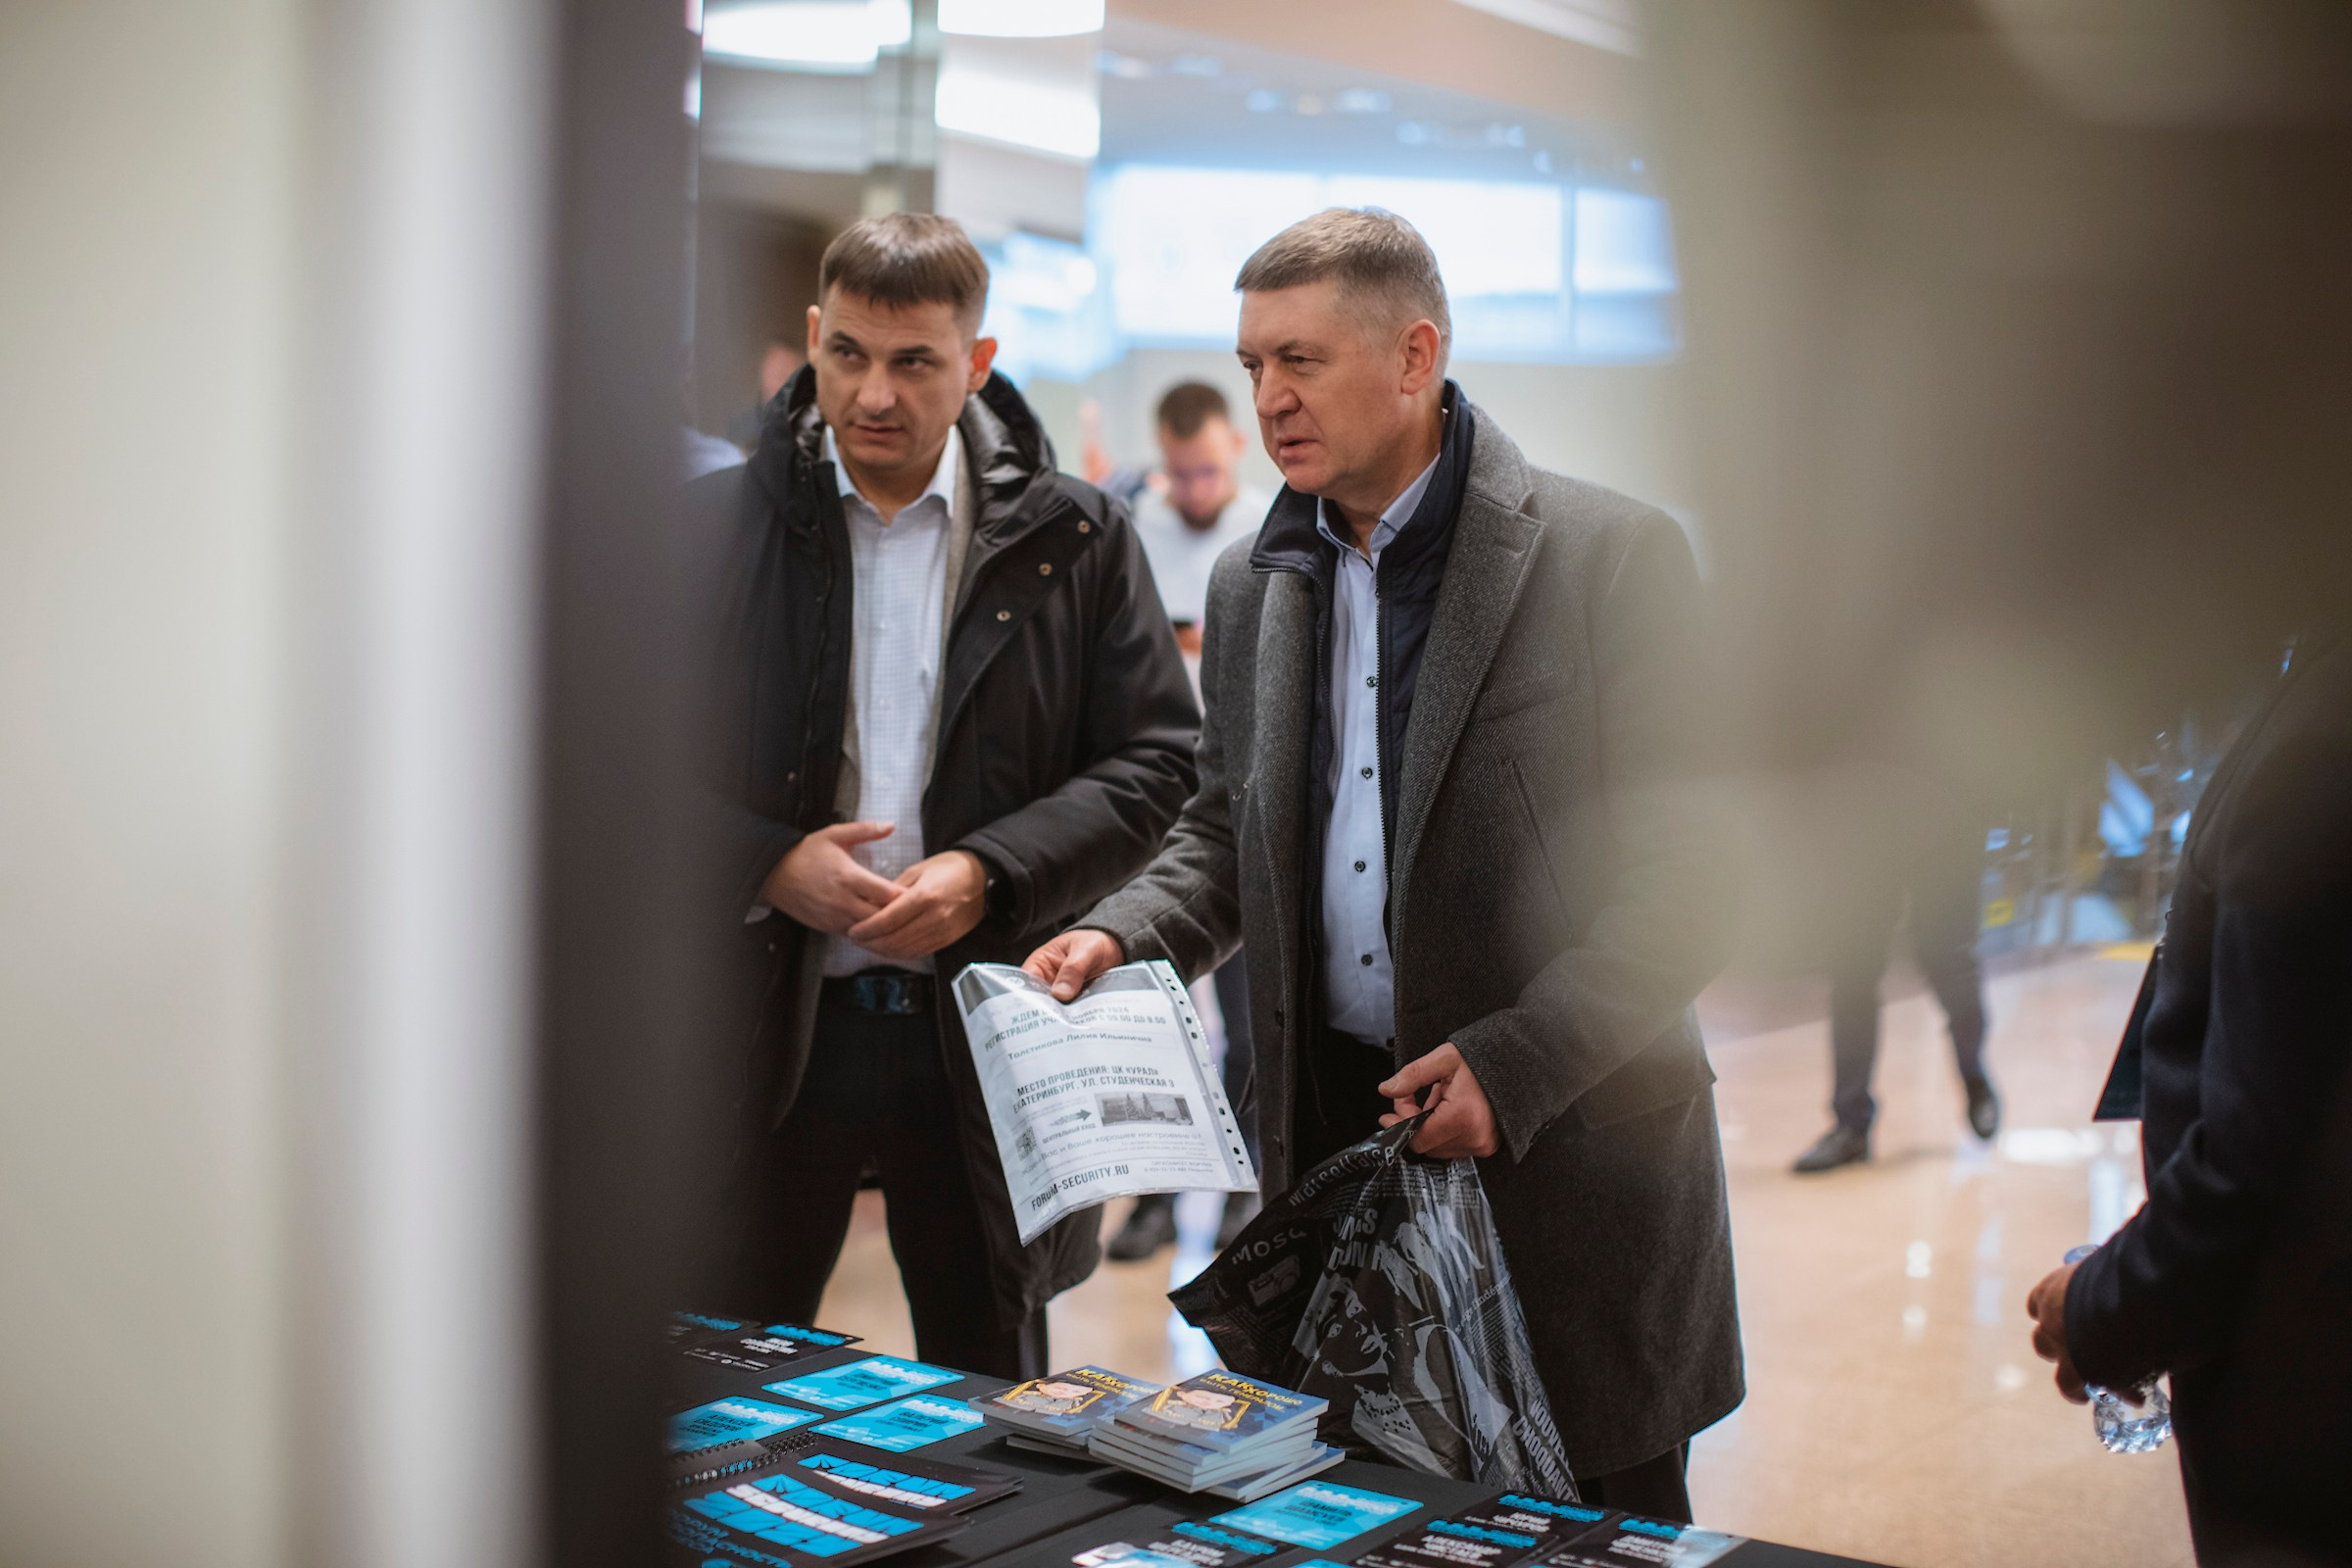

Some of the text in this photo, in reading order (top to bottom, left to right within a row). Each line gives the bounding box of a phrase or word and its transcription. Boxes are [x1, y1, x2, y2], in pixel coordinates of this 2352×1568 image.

[984, 1020, 1040, 1053] РЕГИСТРАЦИЯ
[1007, 1038, 1064, 1060] Толстикова
[1066, 1032, 1098, 1044] Лилия
[1017, 1065, 1159, 1097] МЕСТО ПРОВЕДЕНИЯ: ЦК «УРАЛ»
[1082, 1078, 1099, 1088] УЛ.
[1100, 1076, 1166, 1088] СТУДЕНЧЕСКАЯ
[1169, 1079, 1175, 1088] 3
[1031, 1164, 1130, 1211] FORUM-SECURITY.RU
[1512, 1414, 1581, 1504] CHOQUANT
